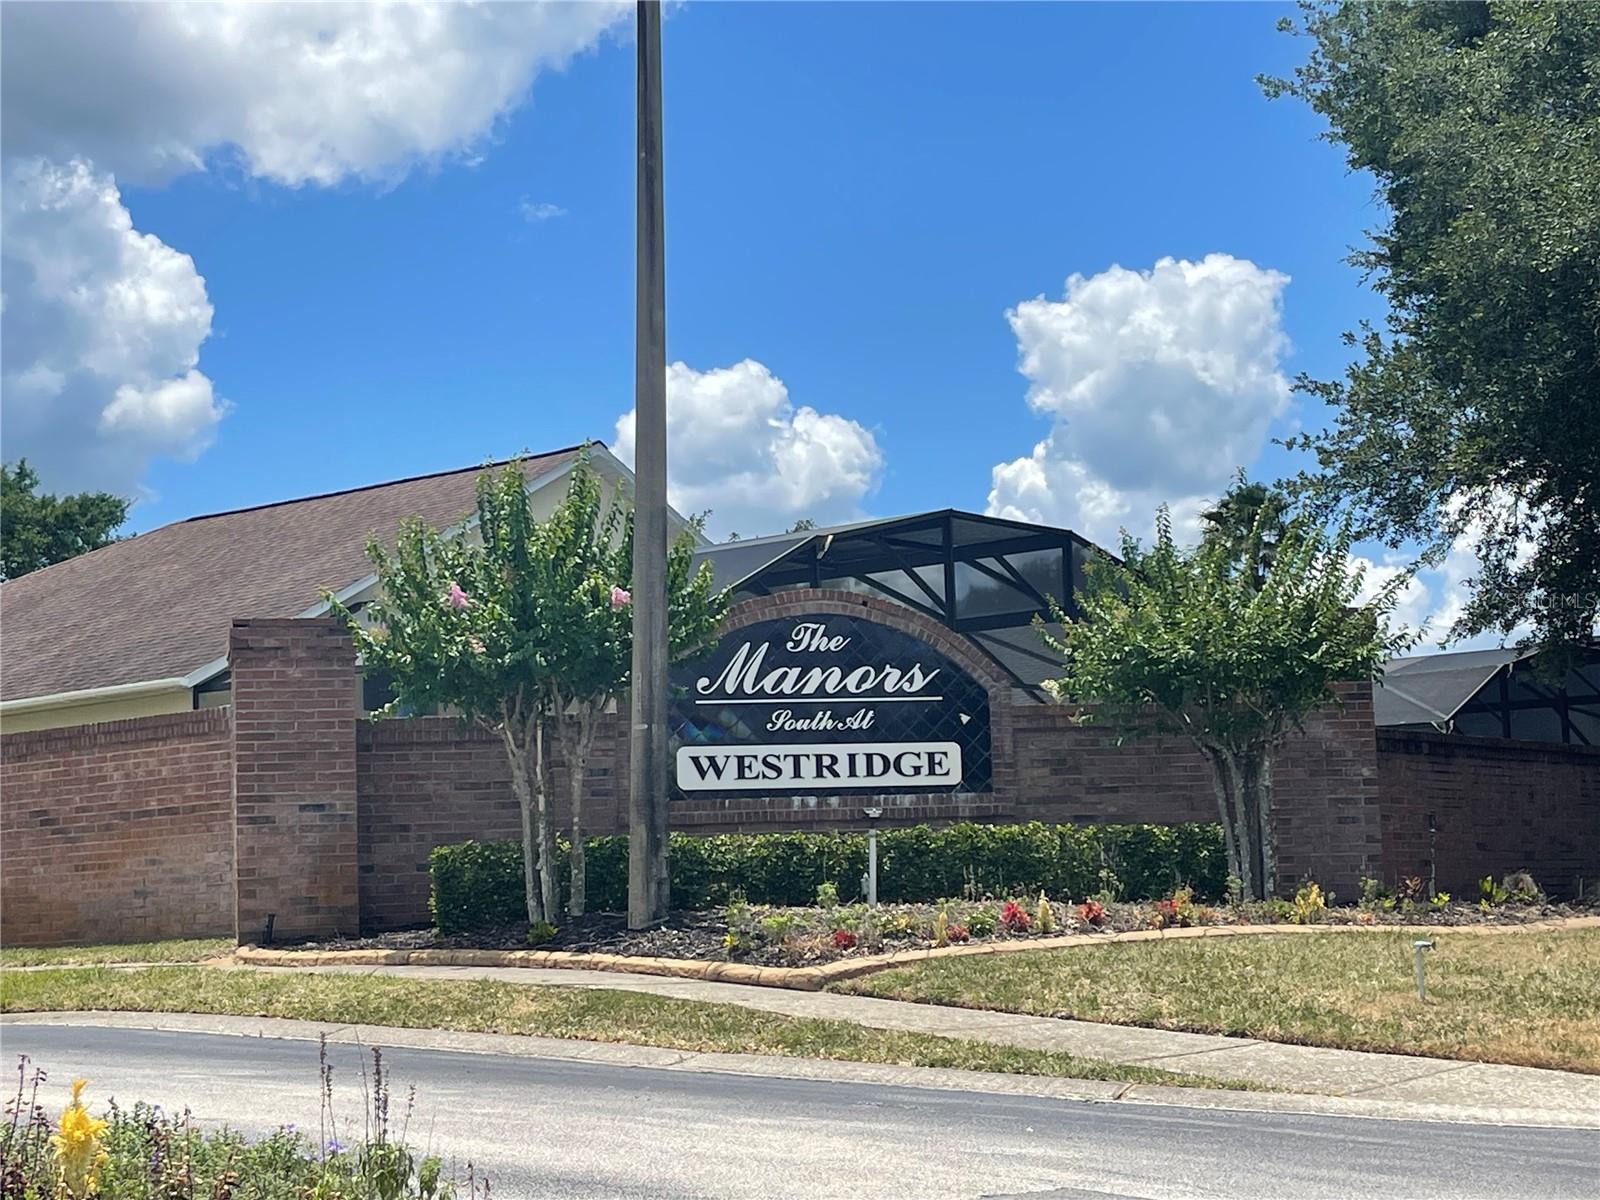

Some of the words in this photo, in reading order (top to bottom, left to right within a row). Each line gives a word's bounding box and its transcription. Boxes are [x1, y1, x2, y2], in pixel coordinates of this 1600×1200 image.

[787, 623, 851, 652] The
[697, 642, 940, 695] Manors
[766, 709, 838, 731] South
[837, 708, 875, 731] At
[689, 751, 951, 781] WESTRIDGE
